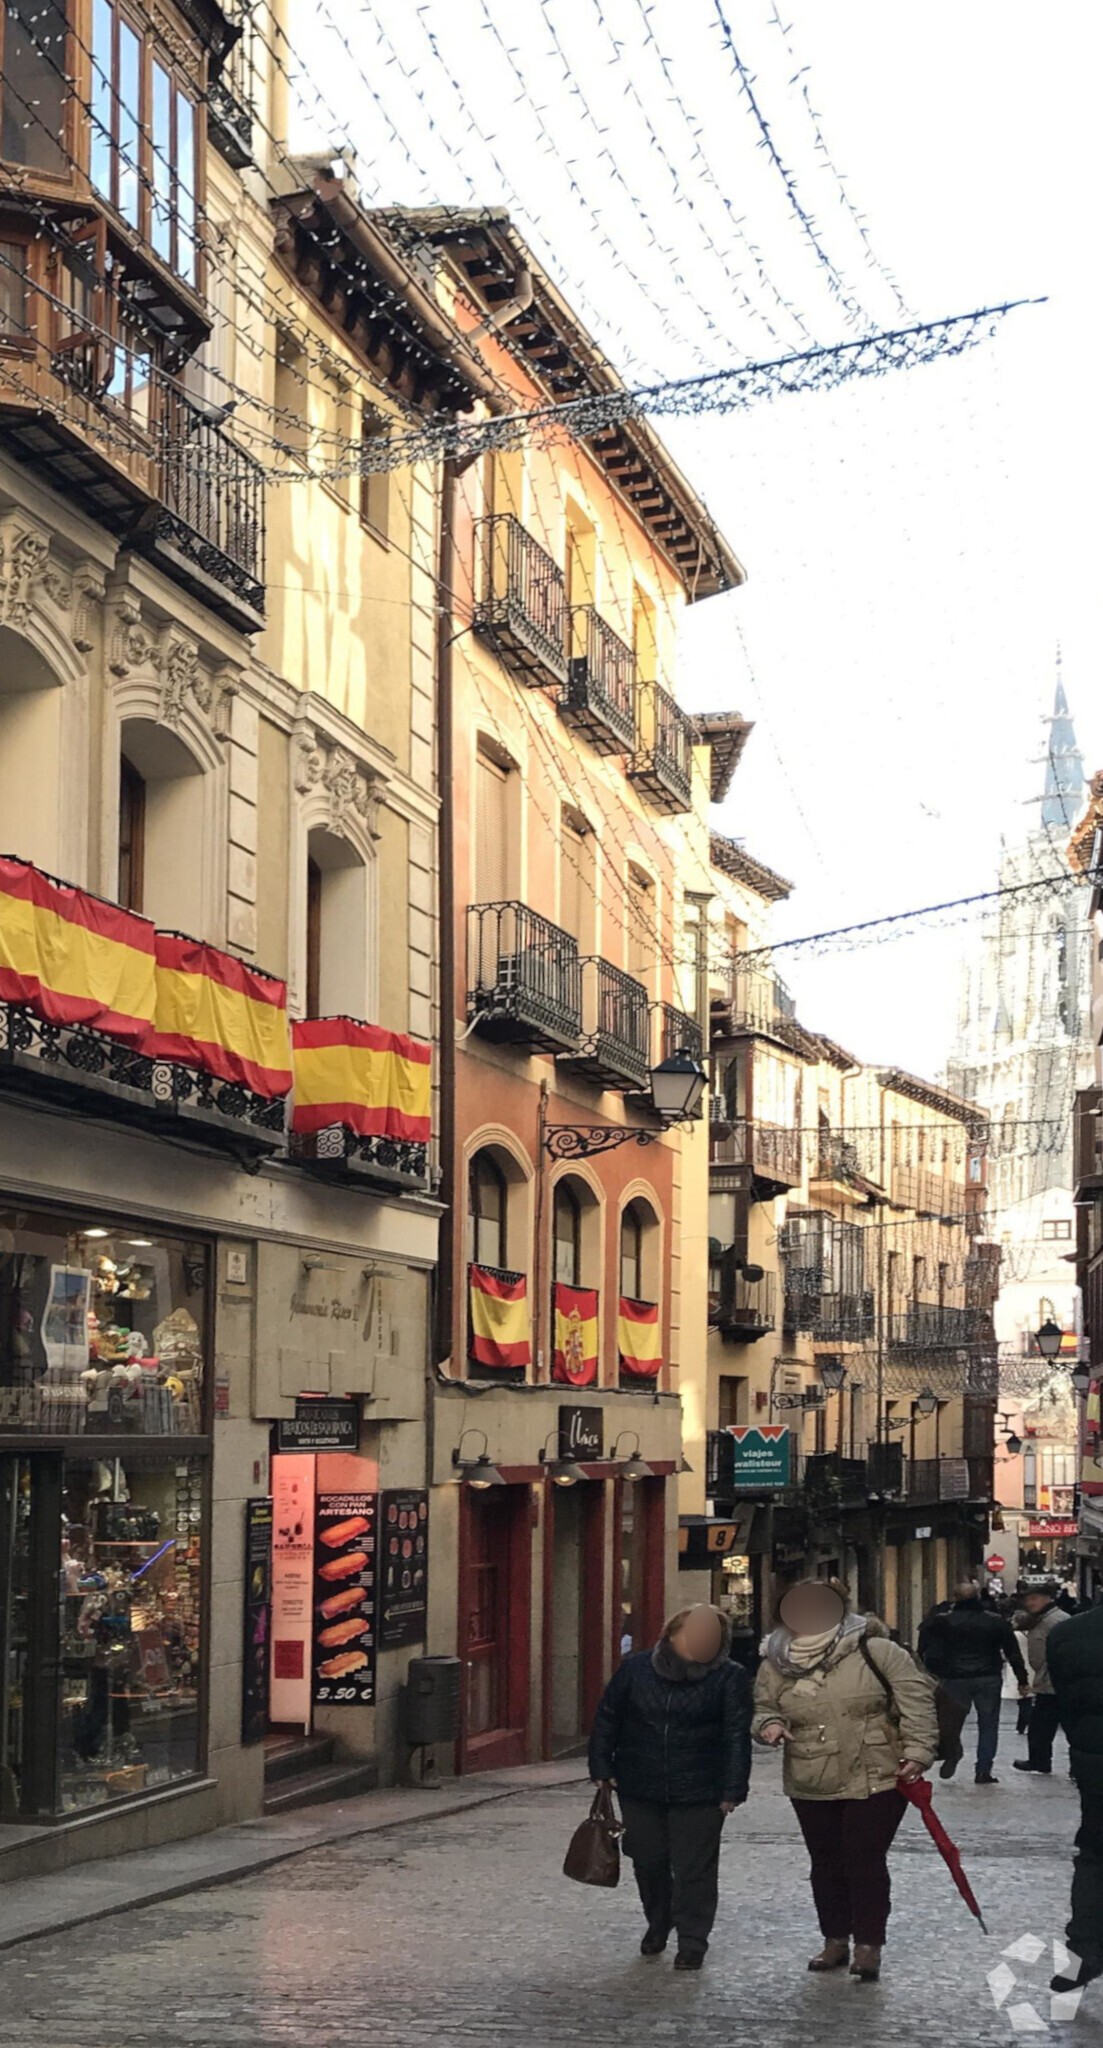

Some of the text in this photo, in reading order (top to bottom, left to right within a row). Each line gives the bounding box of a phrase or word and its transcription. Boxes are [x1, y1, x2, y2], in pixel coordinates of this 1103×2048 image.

[743, 1450, 773, 1458] viajes
[319, 1508, 374, 1516] ARTESANO
[715, 1530, 727, 1547] 8
[316, 1687, 373, 1700] 3.50 €
